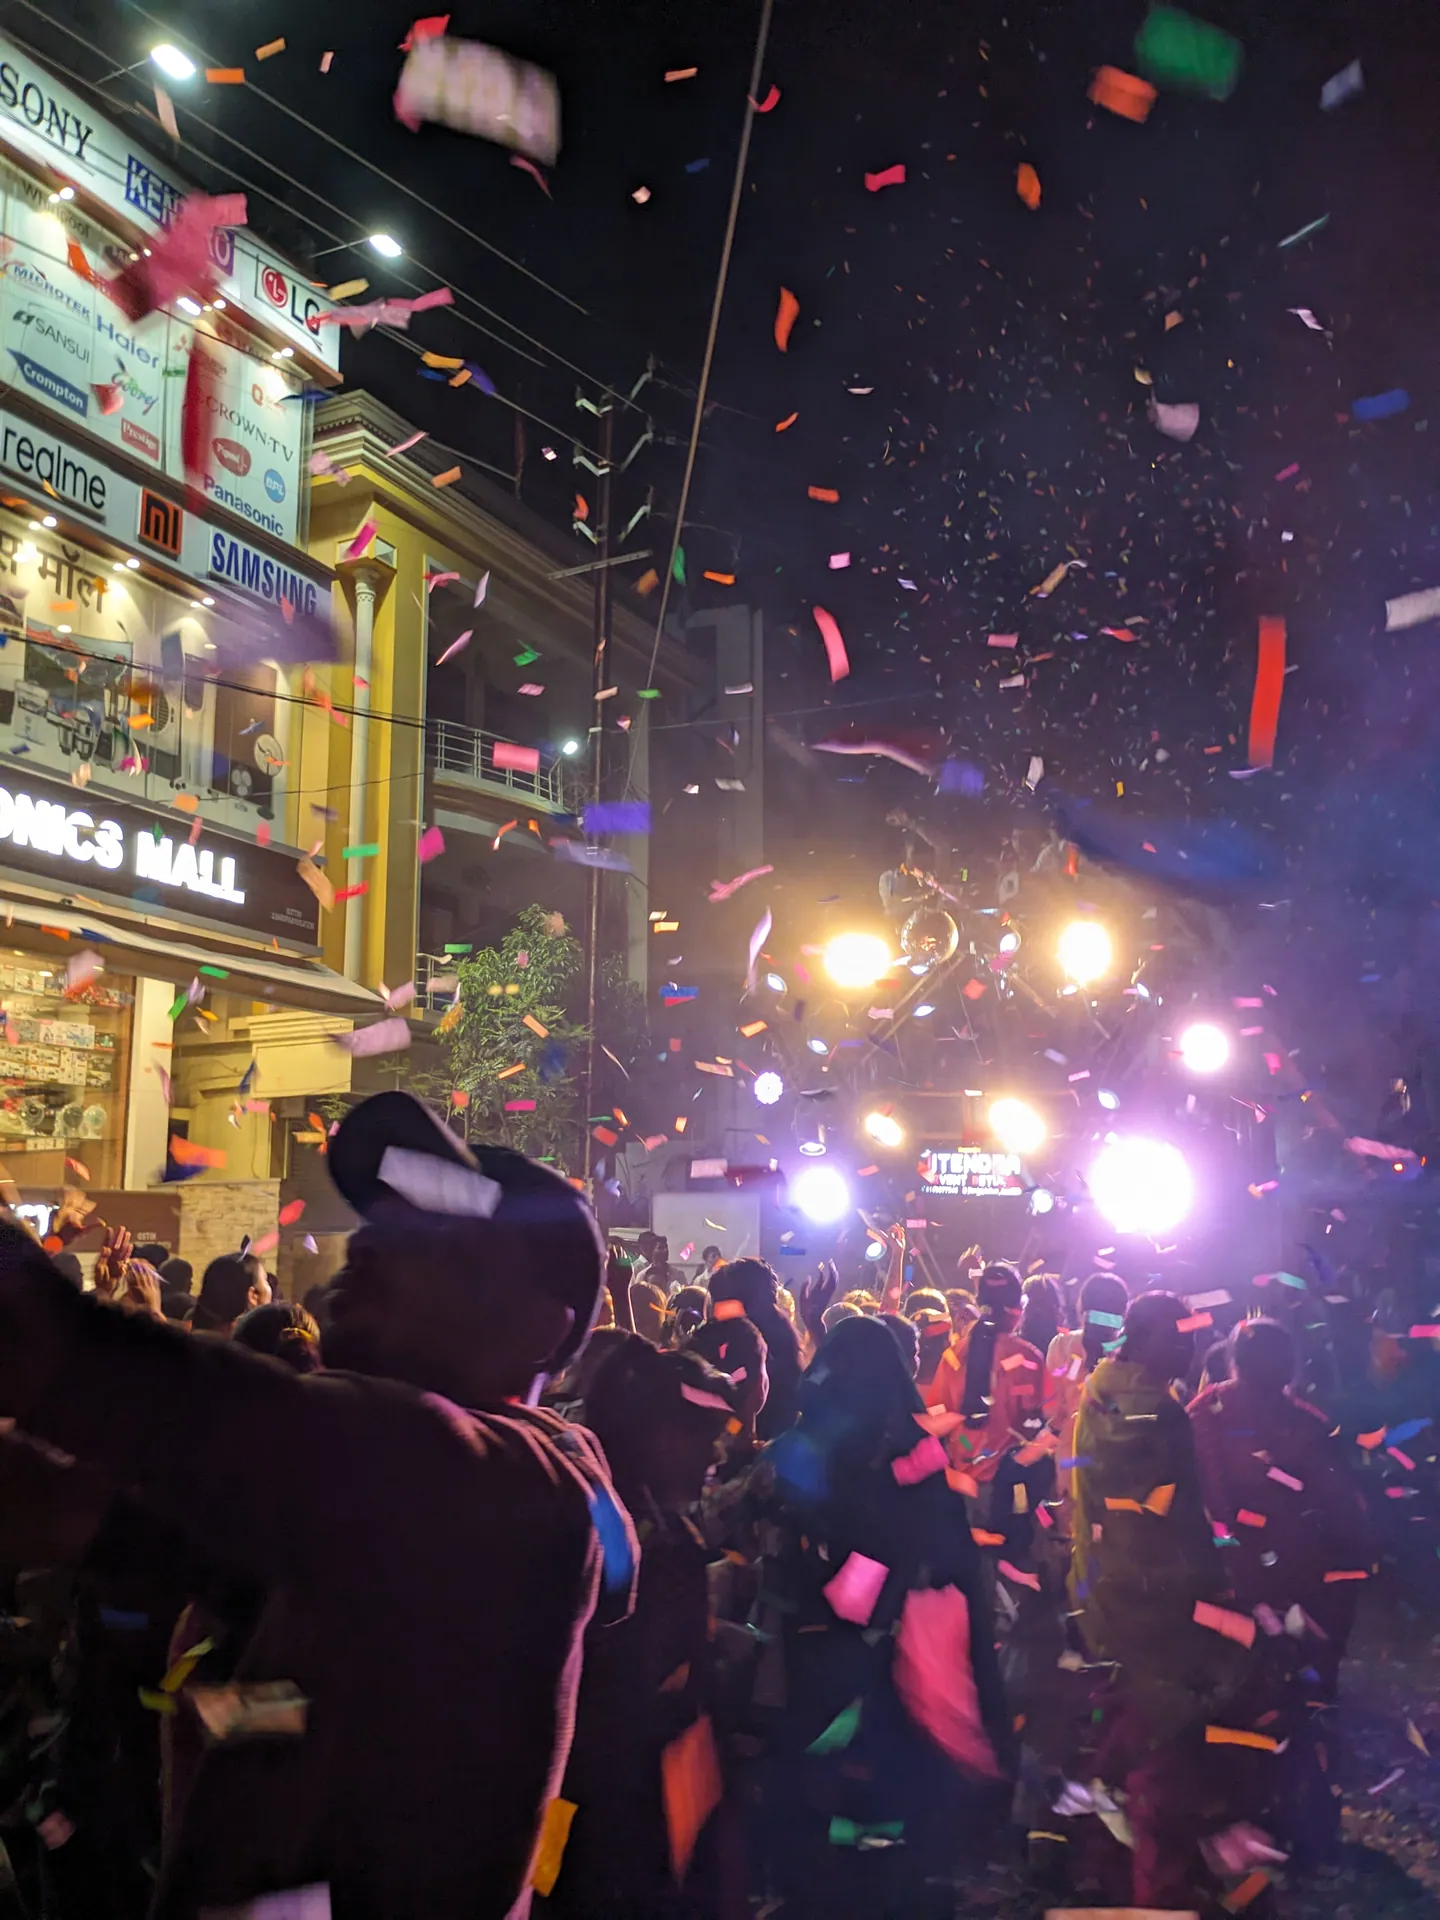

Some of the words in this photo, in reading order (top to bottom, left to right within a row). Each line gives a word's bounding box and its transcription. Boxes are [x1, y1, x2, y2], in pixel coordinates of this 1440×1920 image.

[0, 62, 94, 161] SONY
[14, 266, 91, 319] MICROTEK
[291, 285, 322, 336] LG
[35, 317, 90, 363] SANSUI
[97, 314, 160, 369] Haier
[23, 362, 84, 409] Crompton
[2, 427, 106, 509] realme
[265, 476, 285, 497] BPL
[203, 473, 284, 537] Panasonic
[212, 532, 318, 616] SAMSUNG
[136, 830, 245, 904] MALL
